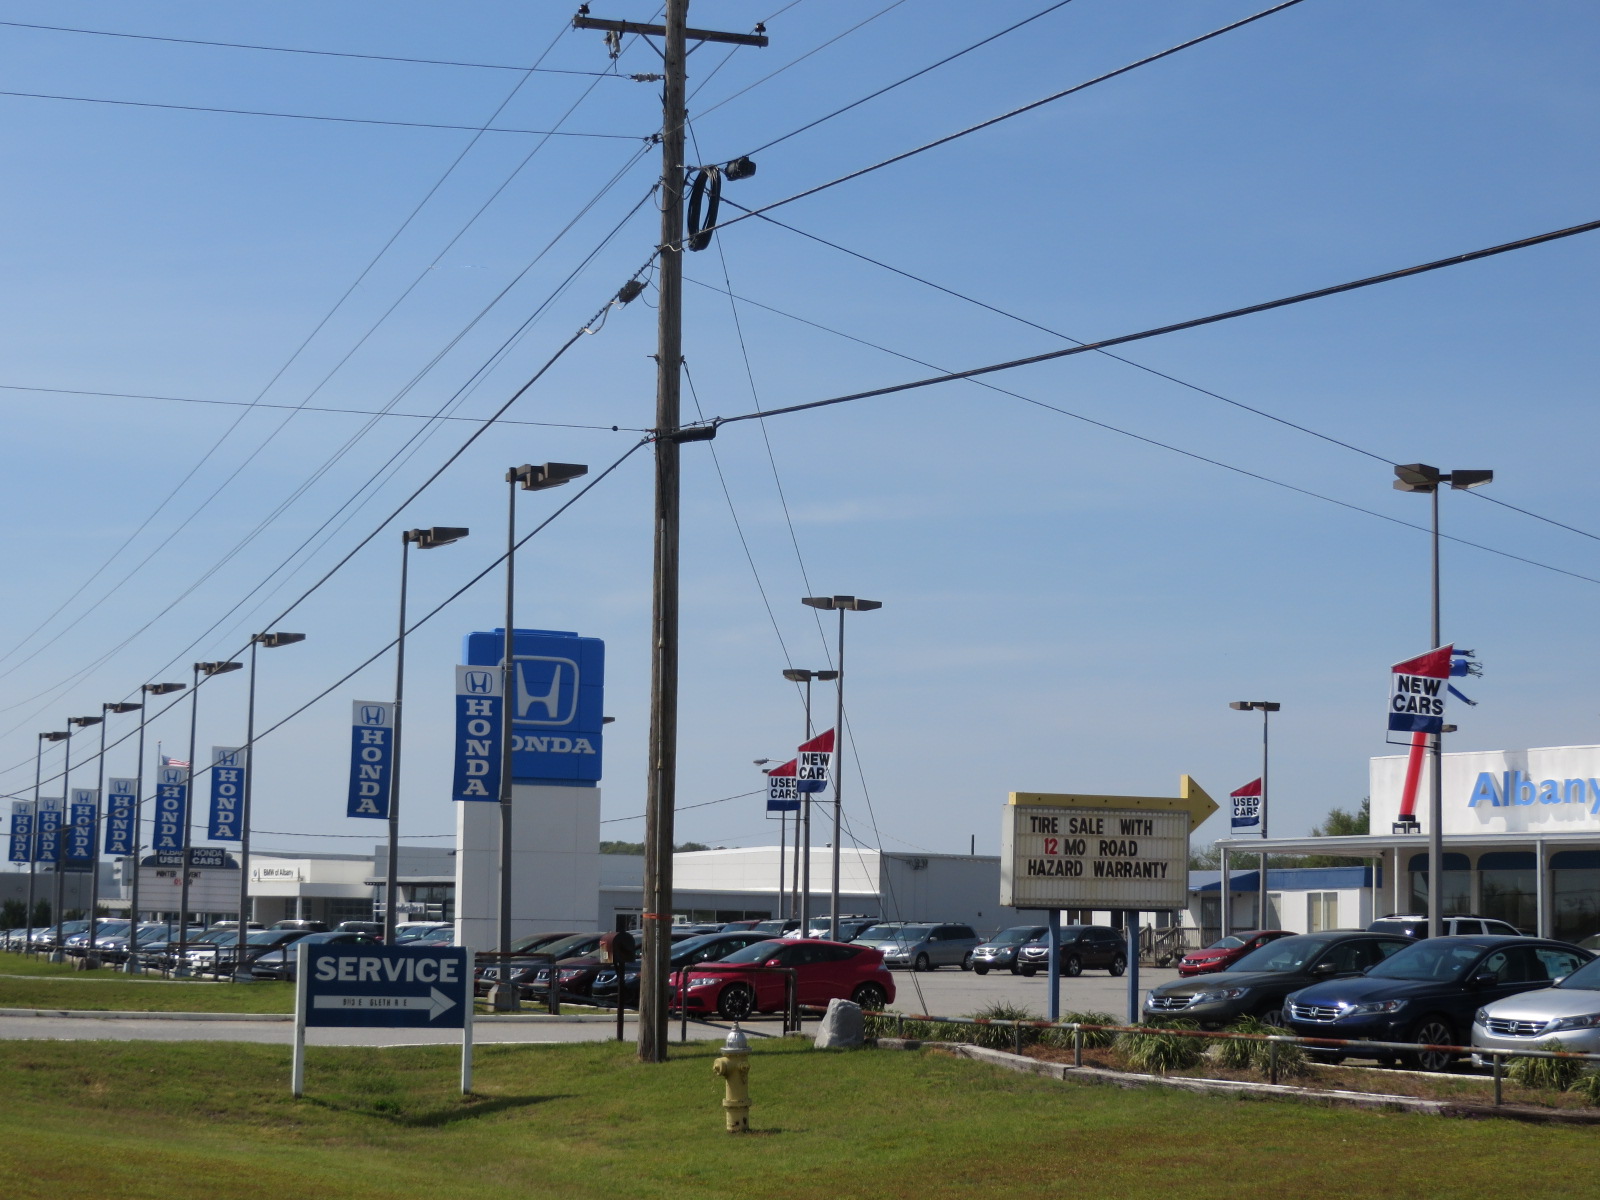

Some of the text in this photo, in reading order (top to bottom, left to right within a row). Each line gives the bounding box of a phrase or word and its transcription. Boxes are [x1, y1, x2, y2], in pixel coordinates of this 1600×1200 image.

[1397, 675, 1441, 697] NEW
[1392, 694, 1444, 716] CARS
[462, 699, 492, 796] HONDA
[512, 735, 596, 754] ONDA
[802, 753, 830, 766] NEW
[356, 729, 384, 813] HONDA
[799, 766, 828, 780] CAR
[215, 769, 238, 837] HONDA
[770, 788, 799, 799] CARS
[1233, 797, 1260, 807] USED
[159, 786, 180, 848] HONDA
[1233, 807, 1259, 816] CARS
[73, 805, 91, 857] HONDA
[110, 796, 130, 852] HONDA
[1030, 816, 1153, 836] TIRE SALE WITH
[13, 816, 29, 860] HONDA
[41, 813, 58, 860] HONDA
[1044, 837, 1138, 857] 12 MO ROAD
[192, 857, 222, 865] CARS
[1027, 859, 1168, 879] HAZARD WARRANTY
[314, 956, 459, 983] SERVICE
